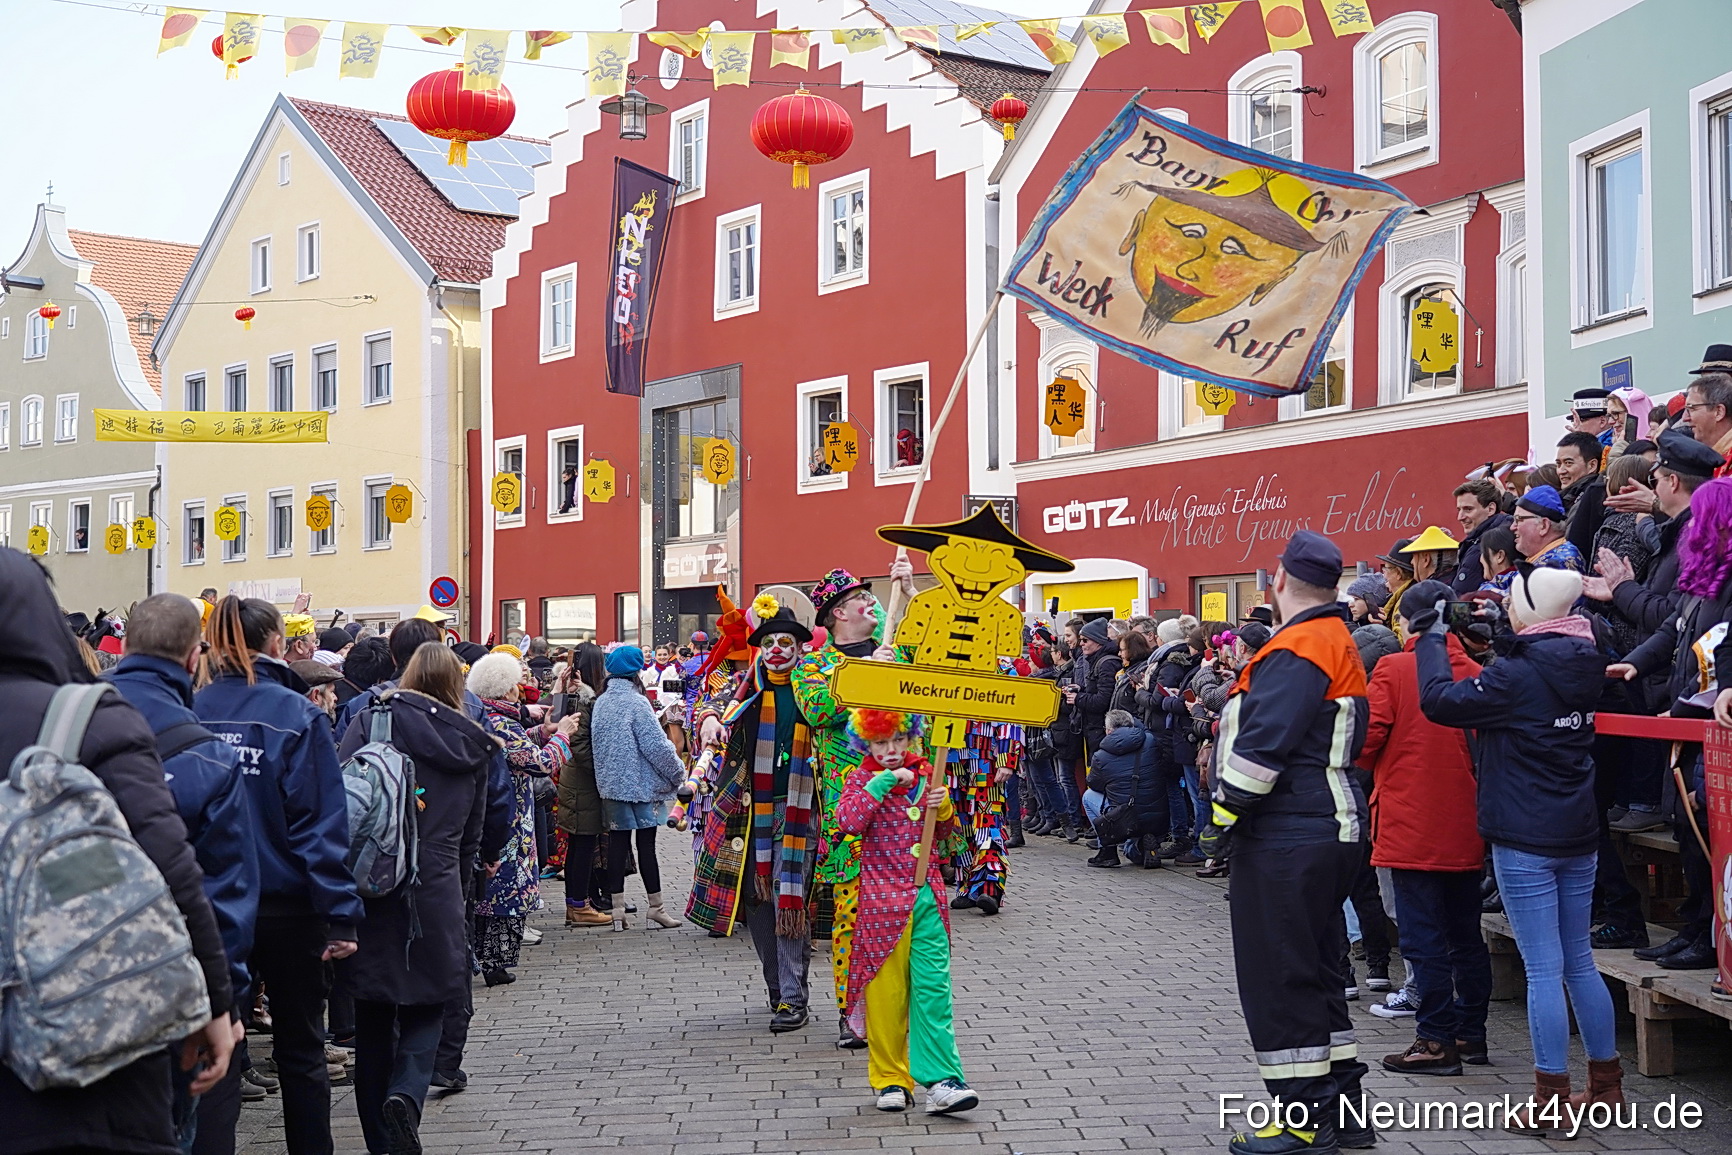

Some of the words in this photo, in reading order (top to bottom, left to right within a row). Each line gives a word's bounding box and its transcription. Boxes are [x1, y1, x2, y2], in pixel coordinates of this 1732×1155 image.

[1213, 318, 1307, 377] Ruf
[1139, 485, 1182, 527] Mode
[1183, 494, 1227, 531] Genuss
[1231, 473, 1288, 515] Erlebnis
[1322, 466, 1424, 536] Erlebnis
[663, 553, 727, 578] GÖTZ
[899, 680, 960, 700] Weckruf
[963, 687, 1016, 705] Dietfurt
[944, 722, 955, 745] 1
